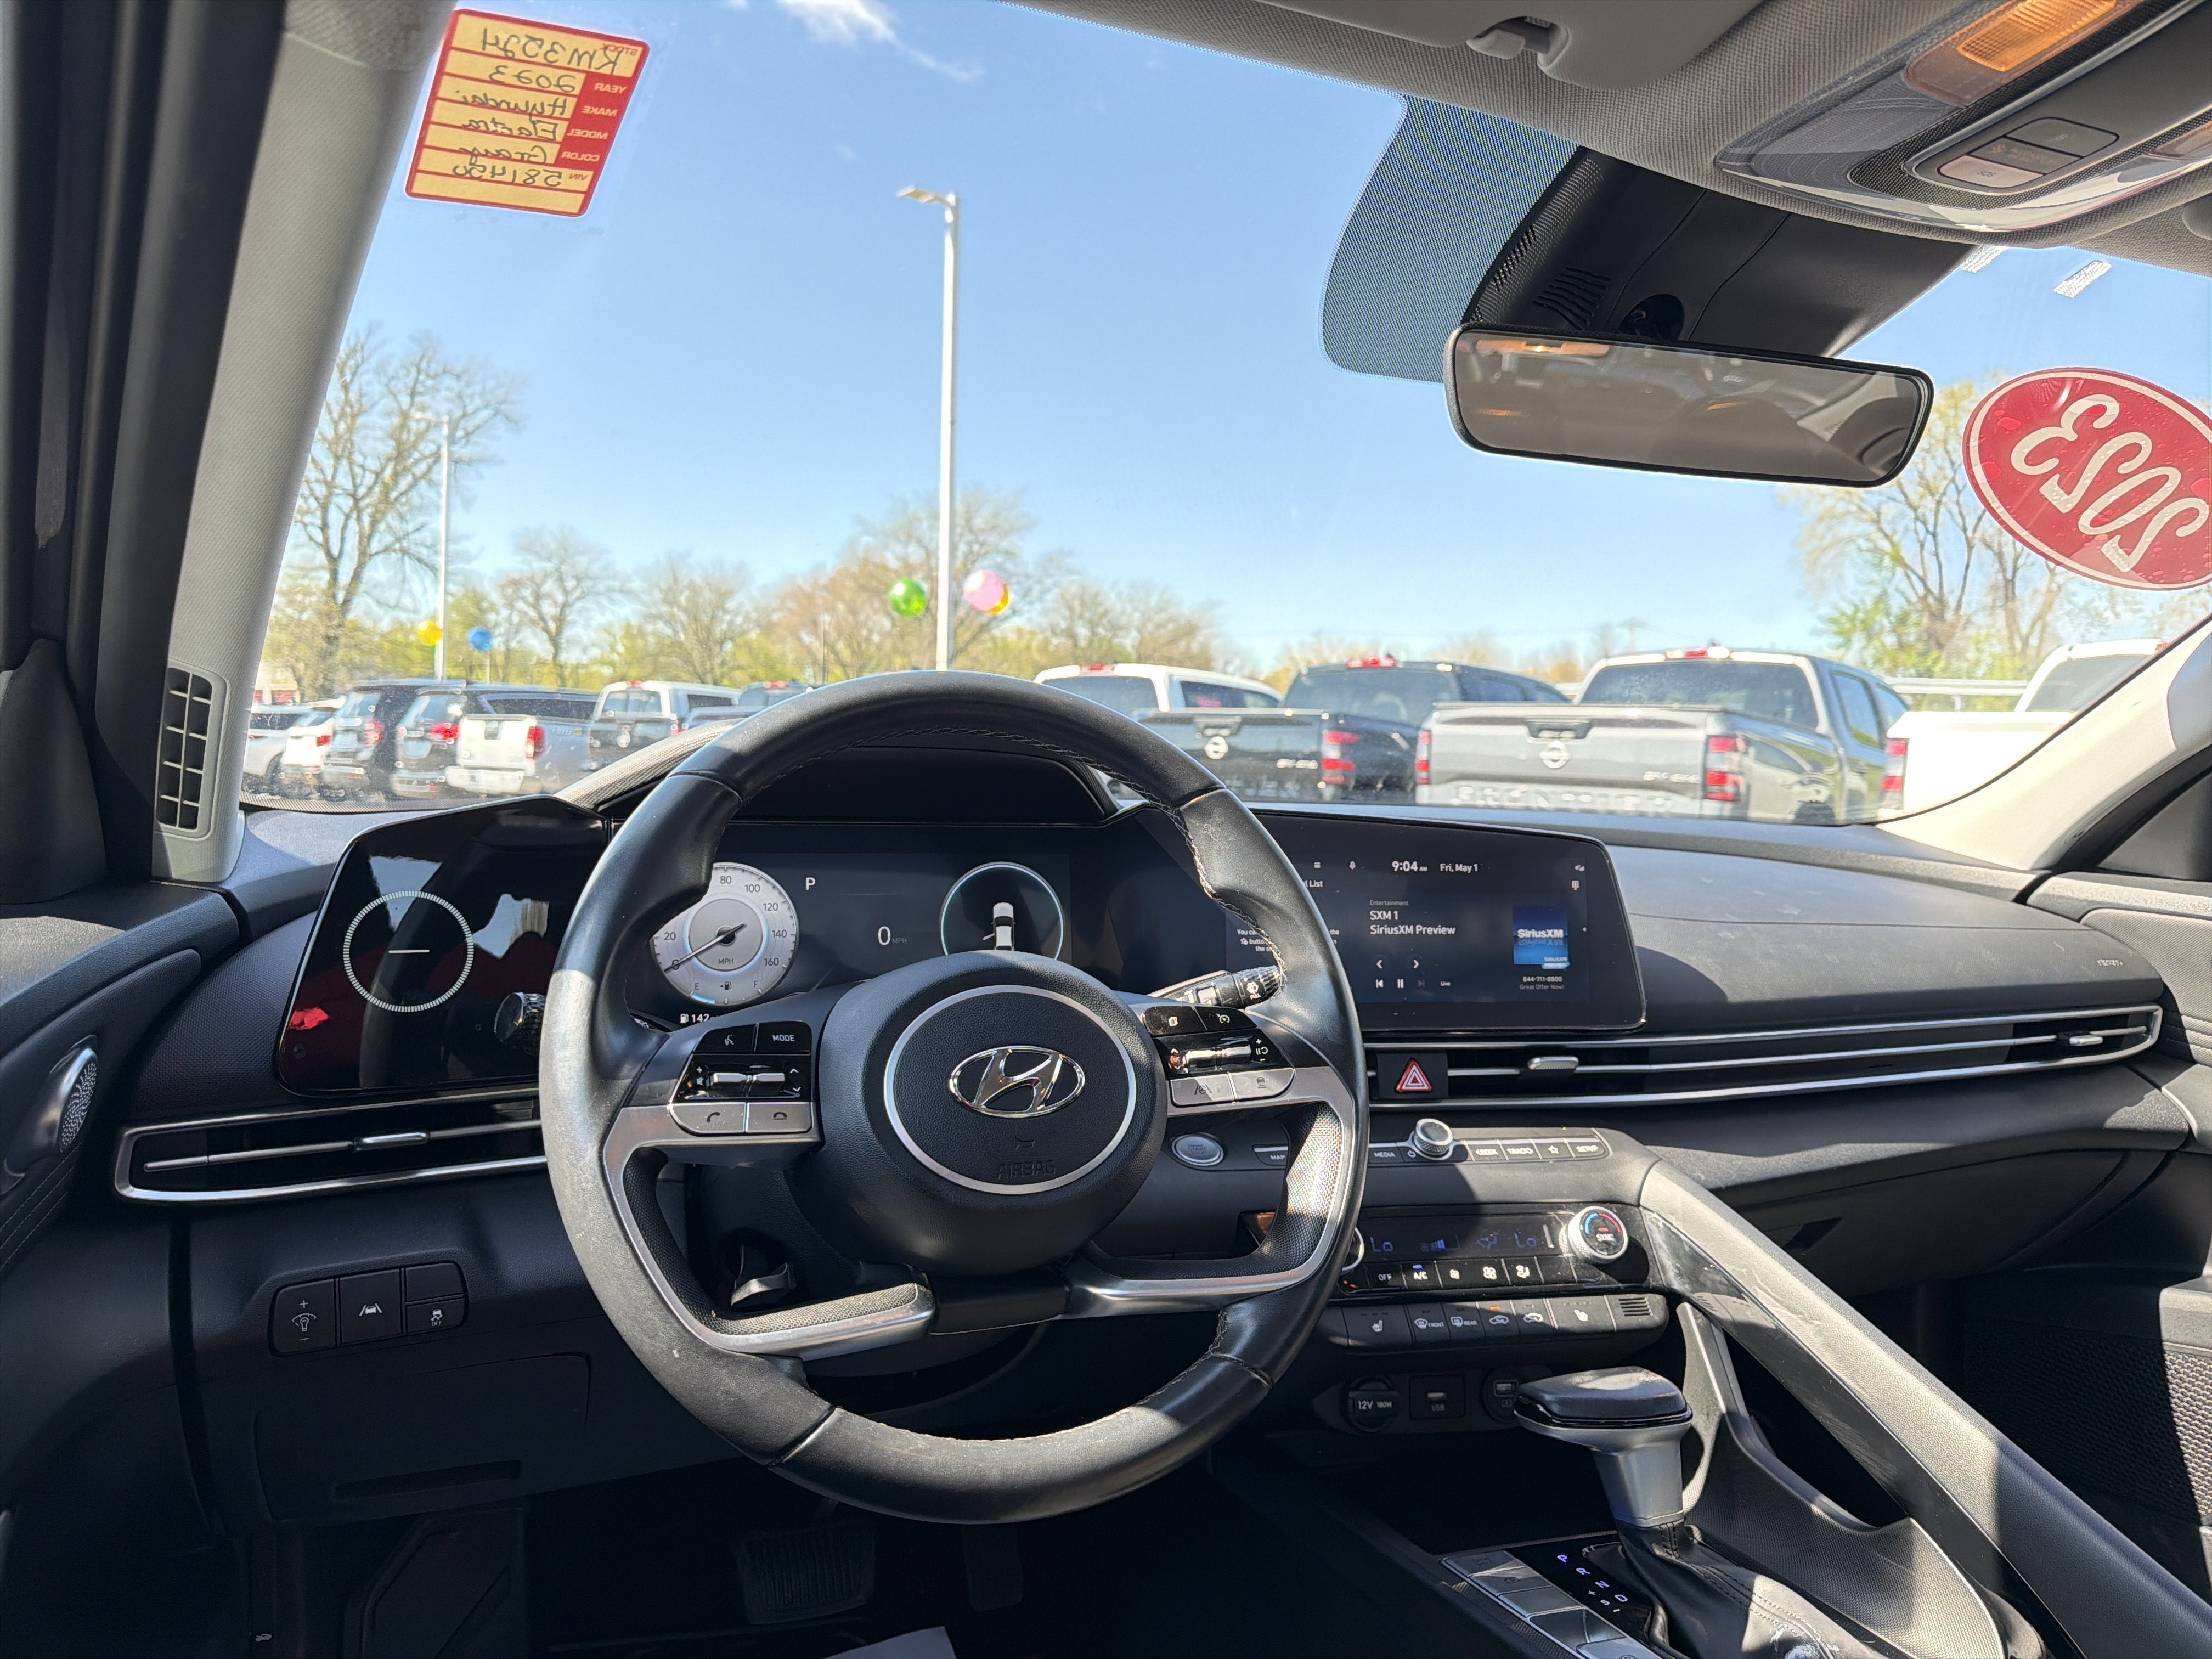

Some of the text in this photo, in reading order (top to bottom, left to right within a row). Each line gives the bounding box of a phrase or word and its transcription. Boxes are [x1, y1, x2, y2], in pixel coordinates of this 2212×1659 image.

[1392, 861, 1418, 872] 9:04
[1440, 864, 1454, 872] Fri,
[1455, 864, 1472, 873] May
[720, 876, 732, 884] 80
[805, 877, 816, 890] P
[745, 884, 760, 893] 100
[763, 903, 778, 911] 120
[1369, 910, 1398, 920] SXM 1
[772, 930, 787, 938] 140
[1370, 925, 1455, 935] SiriusXM Preview
[1517, 929, 1564, 938] SiriusXM
[664, 932, 676, 940] 20
[878, 926, 890, 945] 0
[764, 958, 779, 966] 160
[692, 1014, 709, 1023] 142
[998, 1160, 1056, 1179] AIRBAG
[1596, 1234, 1615, 1242] SYNC
[1378, 1273, 1392, 1282] OFF
[1413, 1272, 1427, 1280] A/C
[1357, 1401, 1374, 1410] 12V
[1431, 1403, 1445, 1412] USB
[1576, 1567, 1590, 1576] R
[1615, 1594, 1628, 1602] D
